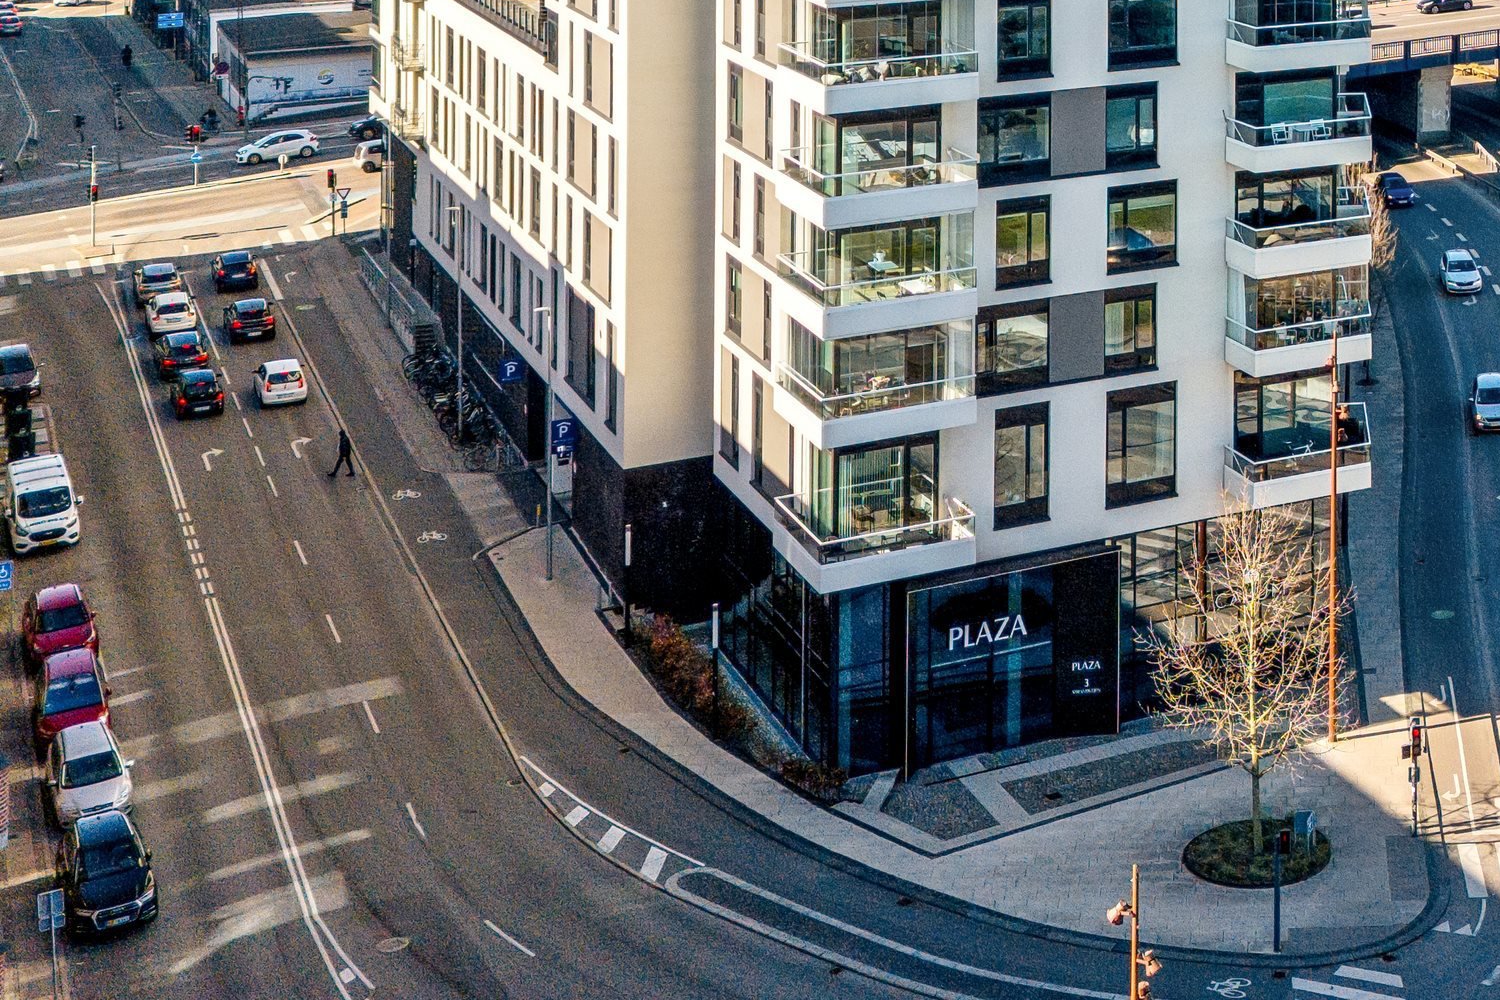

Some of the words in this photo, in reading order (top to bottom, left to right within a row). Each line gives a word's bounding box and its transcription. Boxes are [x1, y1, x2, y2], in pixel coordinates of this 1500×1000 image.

[506, 365, 516, 377] P
[559, 425, 568, 438] P
[948, 614, 1028, 651] PLAZA
[1071, 660, 1101, 672] PLAZA
[1083, 678, 1090, 688] 3
